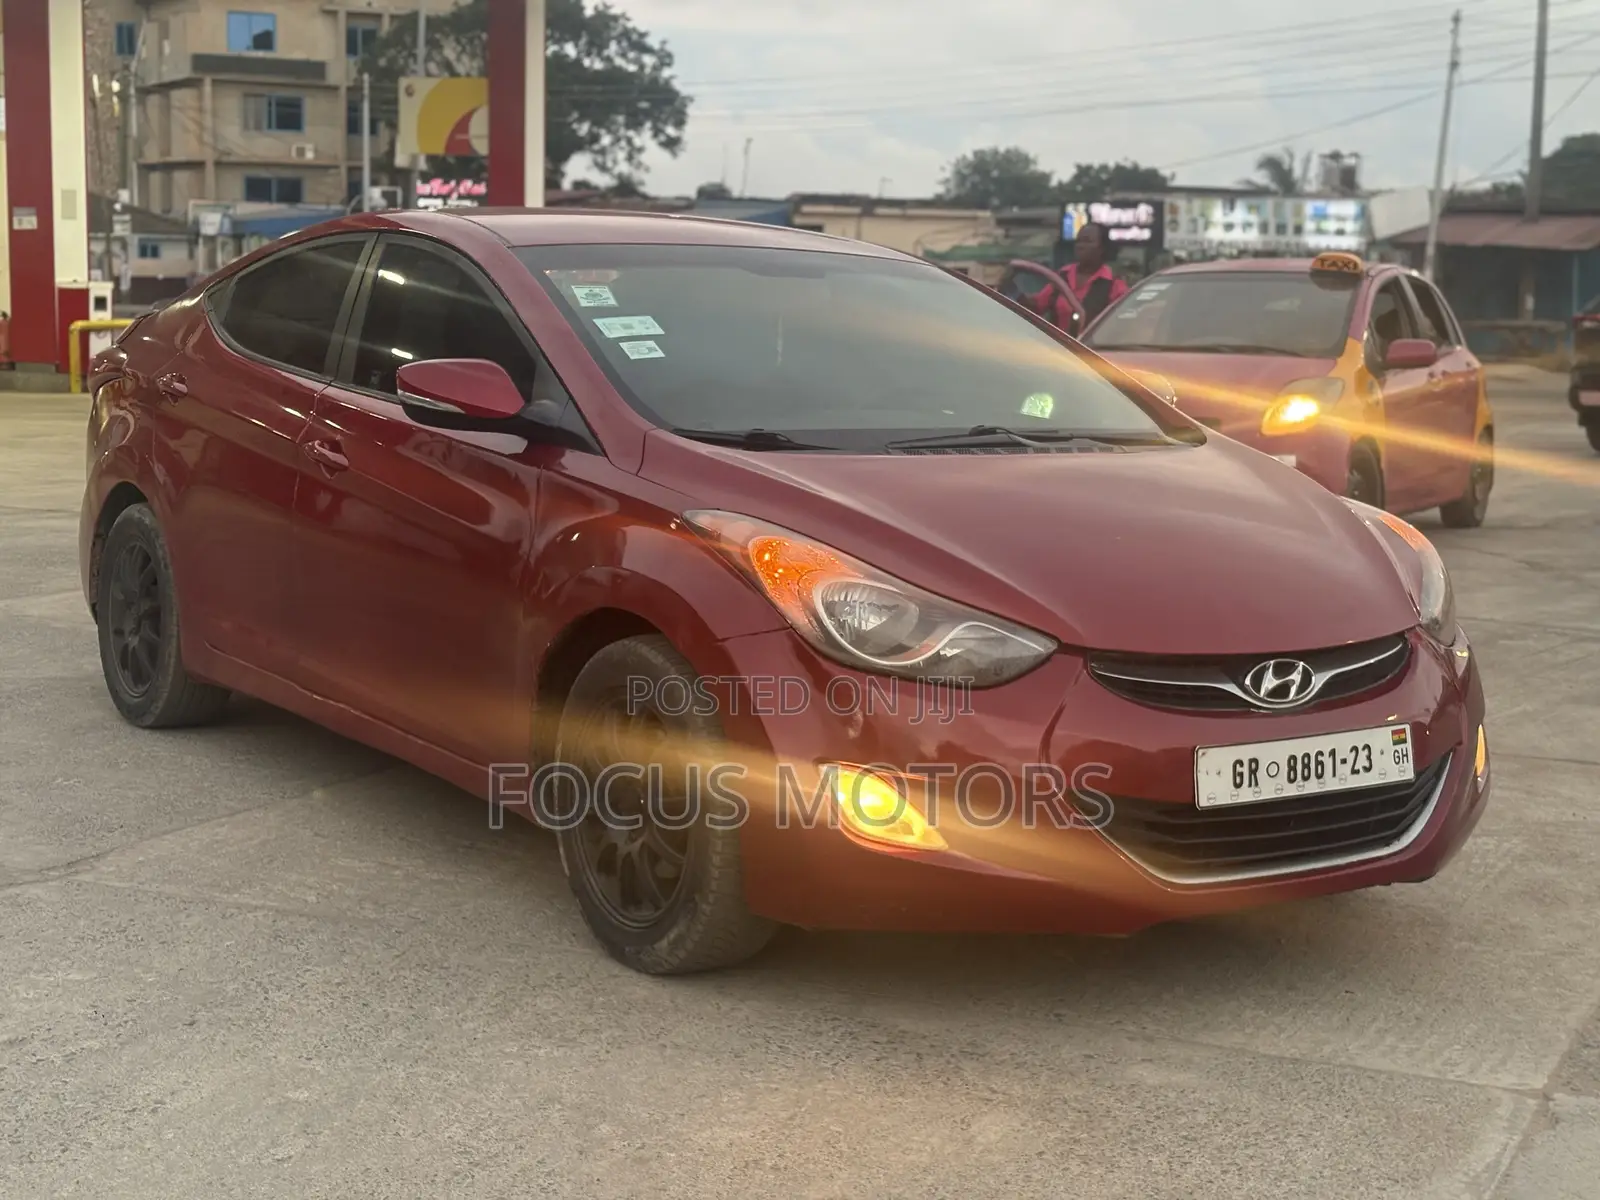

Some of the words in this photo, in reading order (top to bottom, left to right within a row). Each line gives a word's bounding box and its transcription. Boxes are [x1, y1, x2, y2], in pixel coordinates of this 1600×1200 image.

[1318, 258, 1358, 271] TAXI
[1393, 747, 1409, 766] GH
[1232, 758, 1260, 789] GR
[1287, 744, 1373, 784] 8861-23
